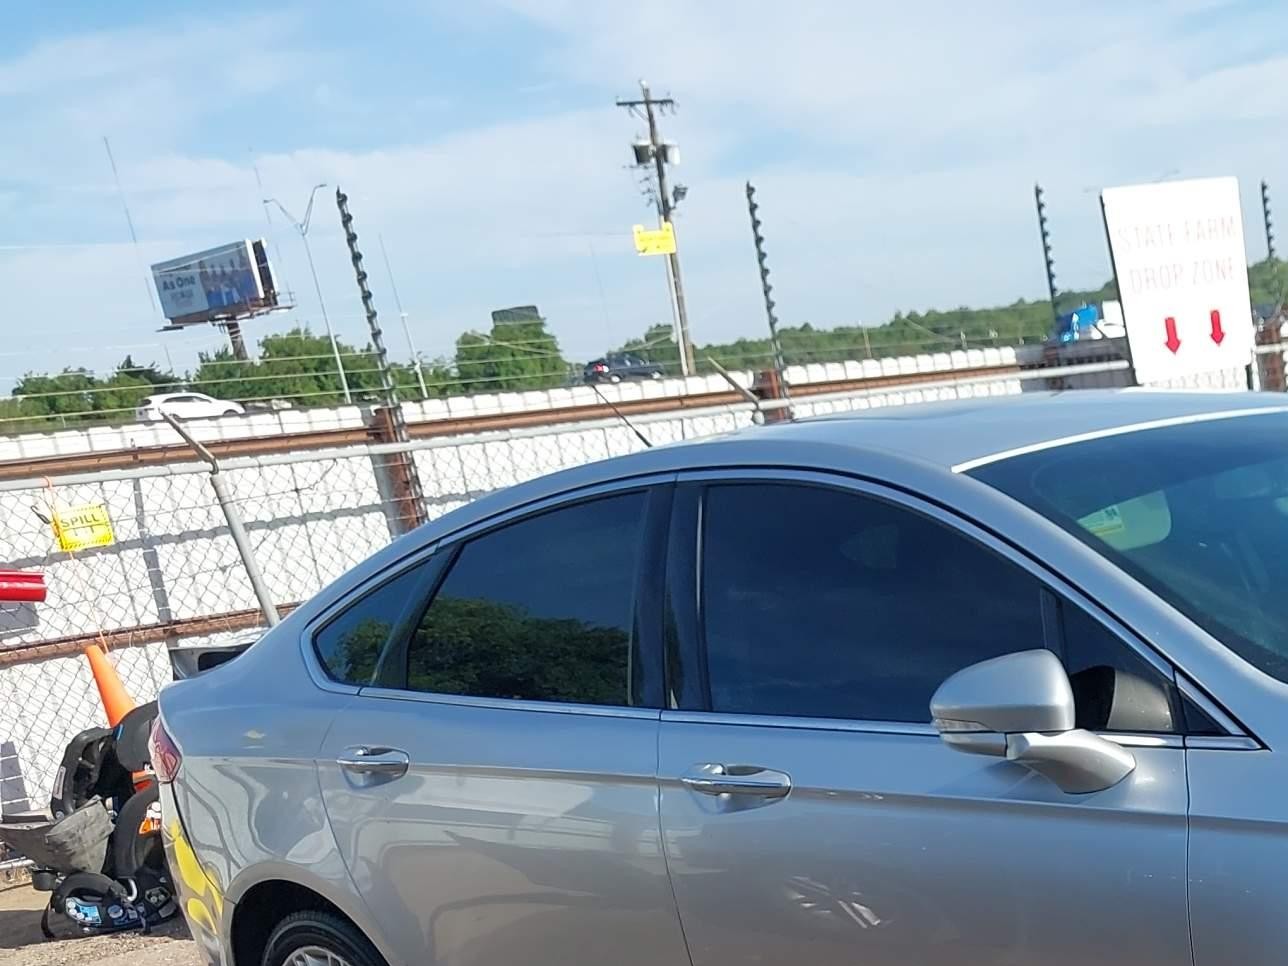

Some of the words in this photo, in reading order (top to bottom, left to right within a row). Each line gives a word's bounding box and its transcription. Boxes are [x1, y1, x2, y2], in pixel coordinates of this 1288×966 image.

[1117, 222, 1176, 253] STATE
[1184, 214, 1237, 242] FARM
[162, 279, 177, 291] As
[176, 275, 196, 288] One
[1129, 262, 1184, 295] DROP
[1191, 256, 1236, 286] ZONE
[60, 513, 101, 528] SPILL
